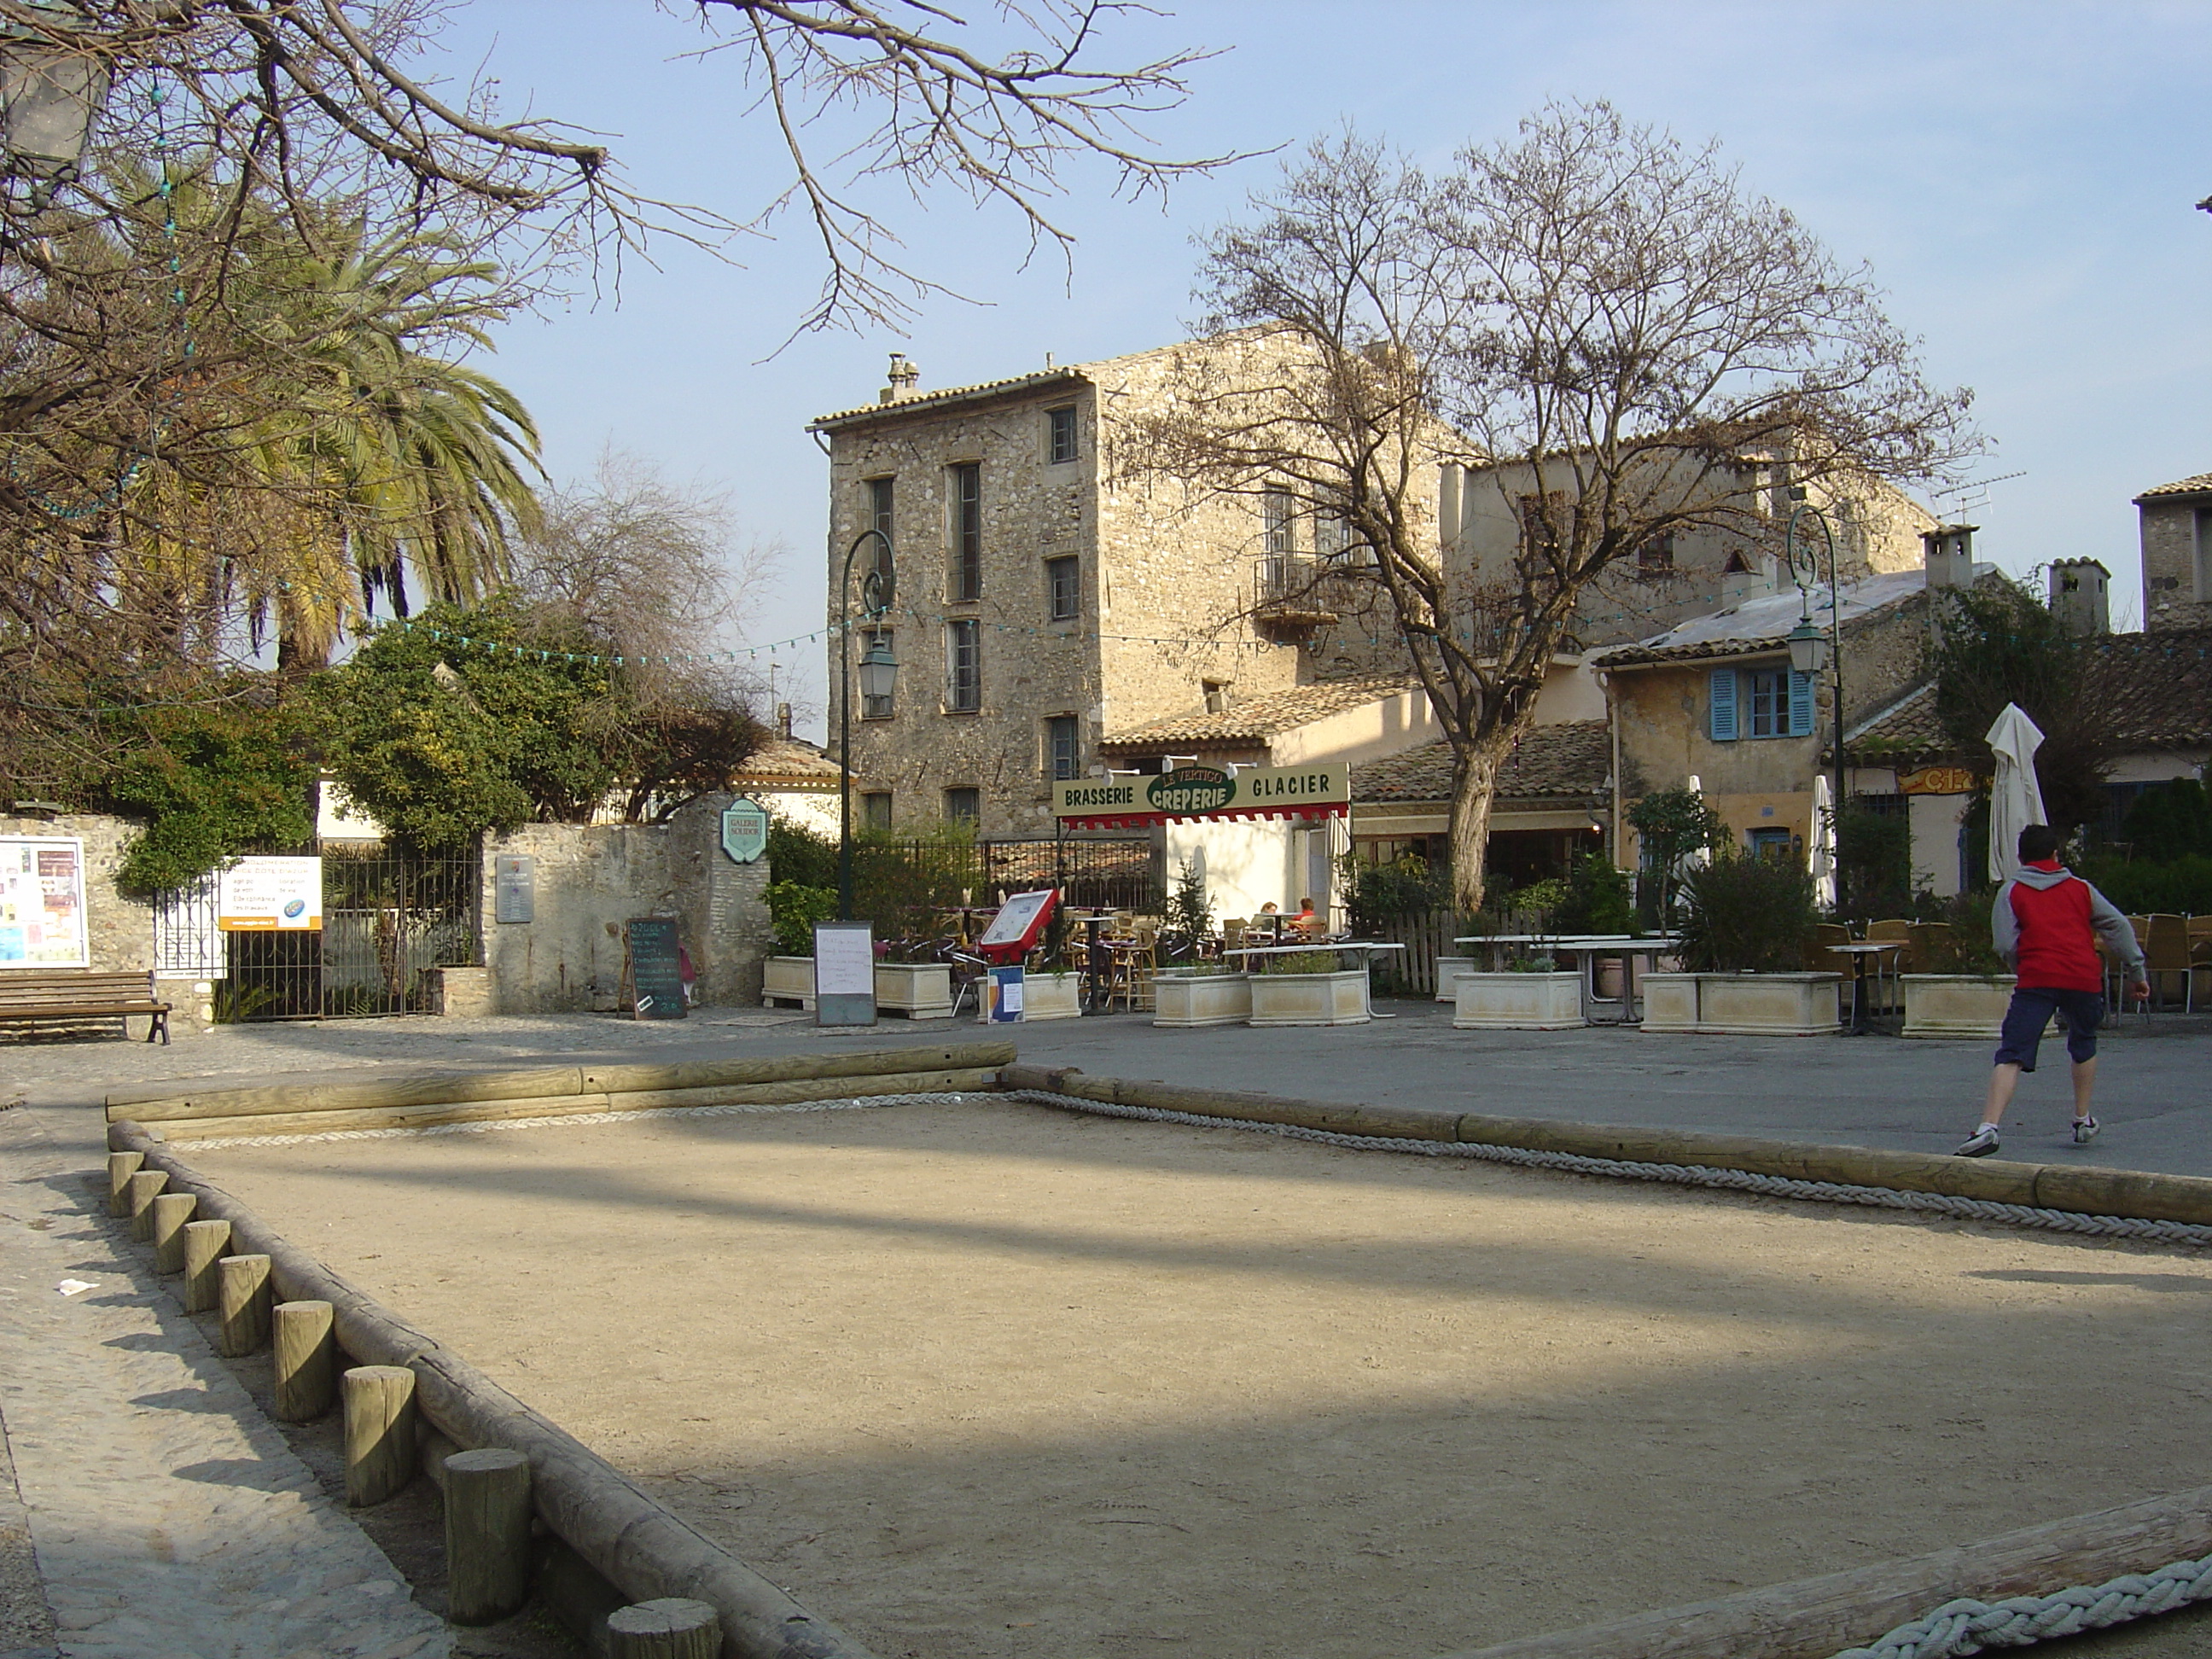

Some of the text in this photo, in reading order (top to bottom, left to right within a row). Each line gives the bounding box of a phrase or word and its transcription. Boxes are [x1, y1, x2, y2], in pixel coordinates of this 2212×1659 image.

[1161, 769, 1224, 788] LE VERTIGO
[1253, 774, 1330, 797] GLACIER
[1064, 786, 1133, 806] BRASSERIE
[1150, 787, 1227, 811] CREPERIE
